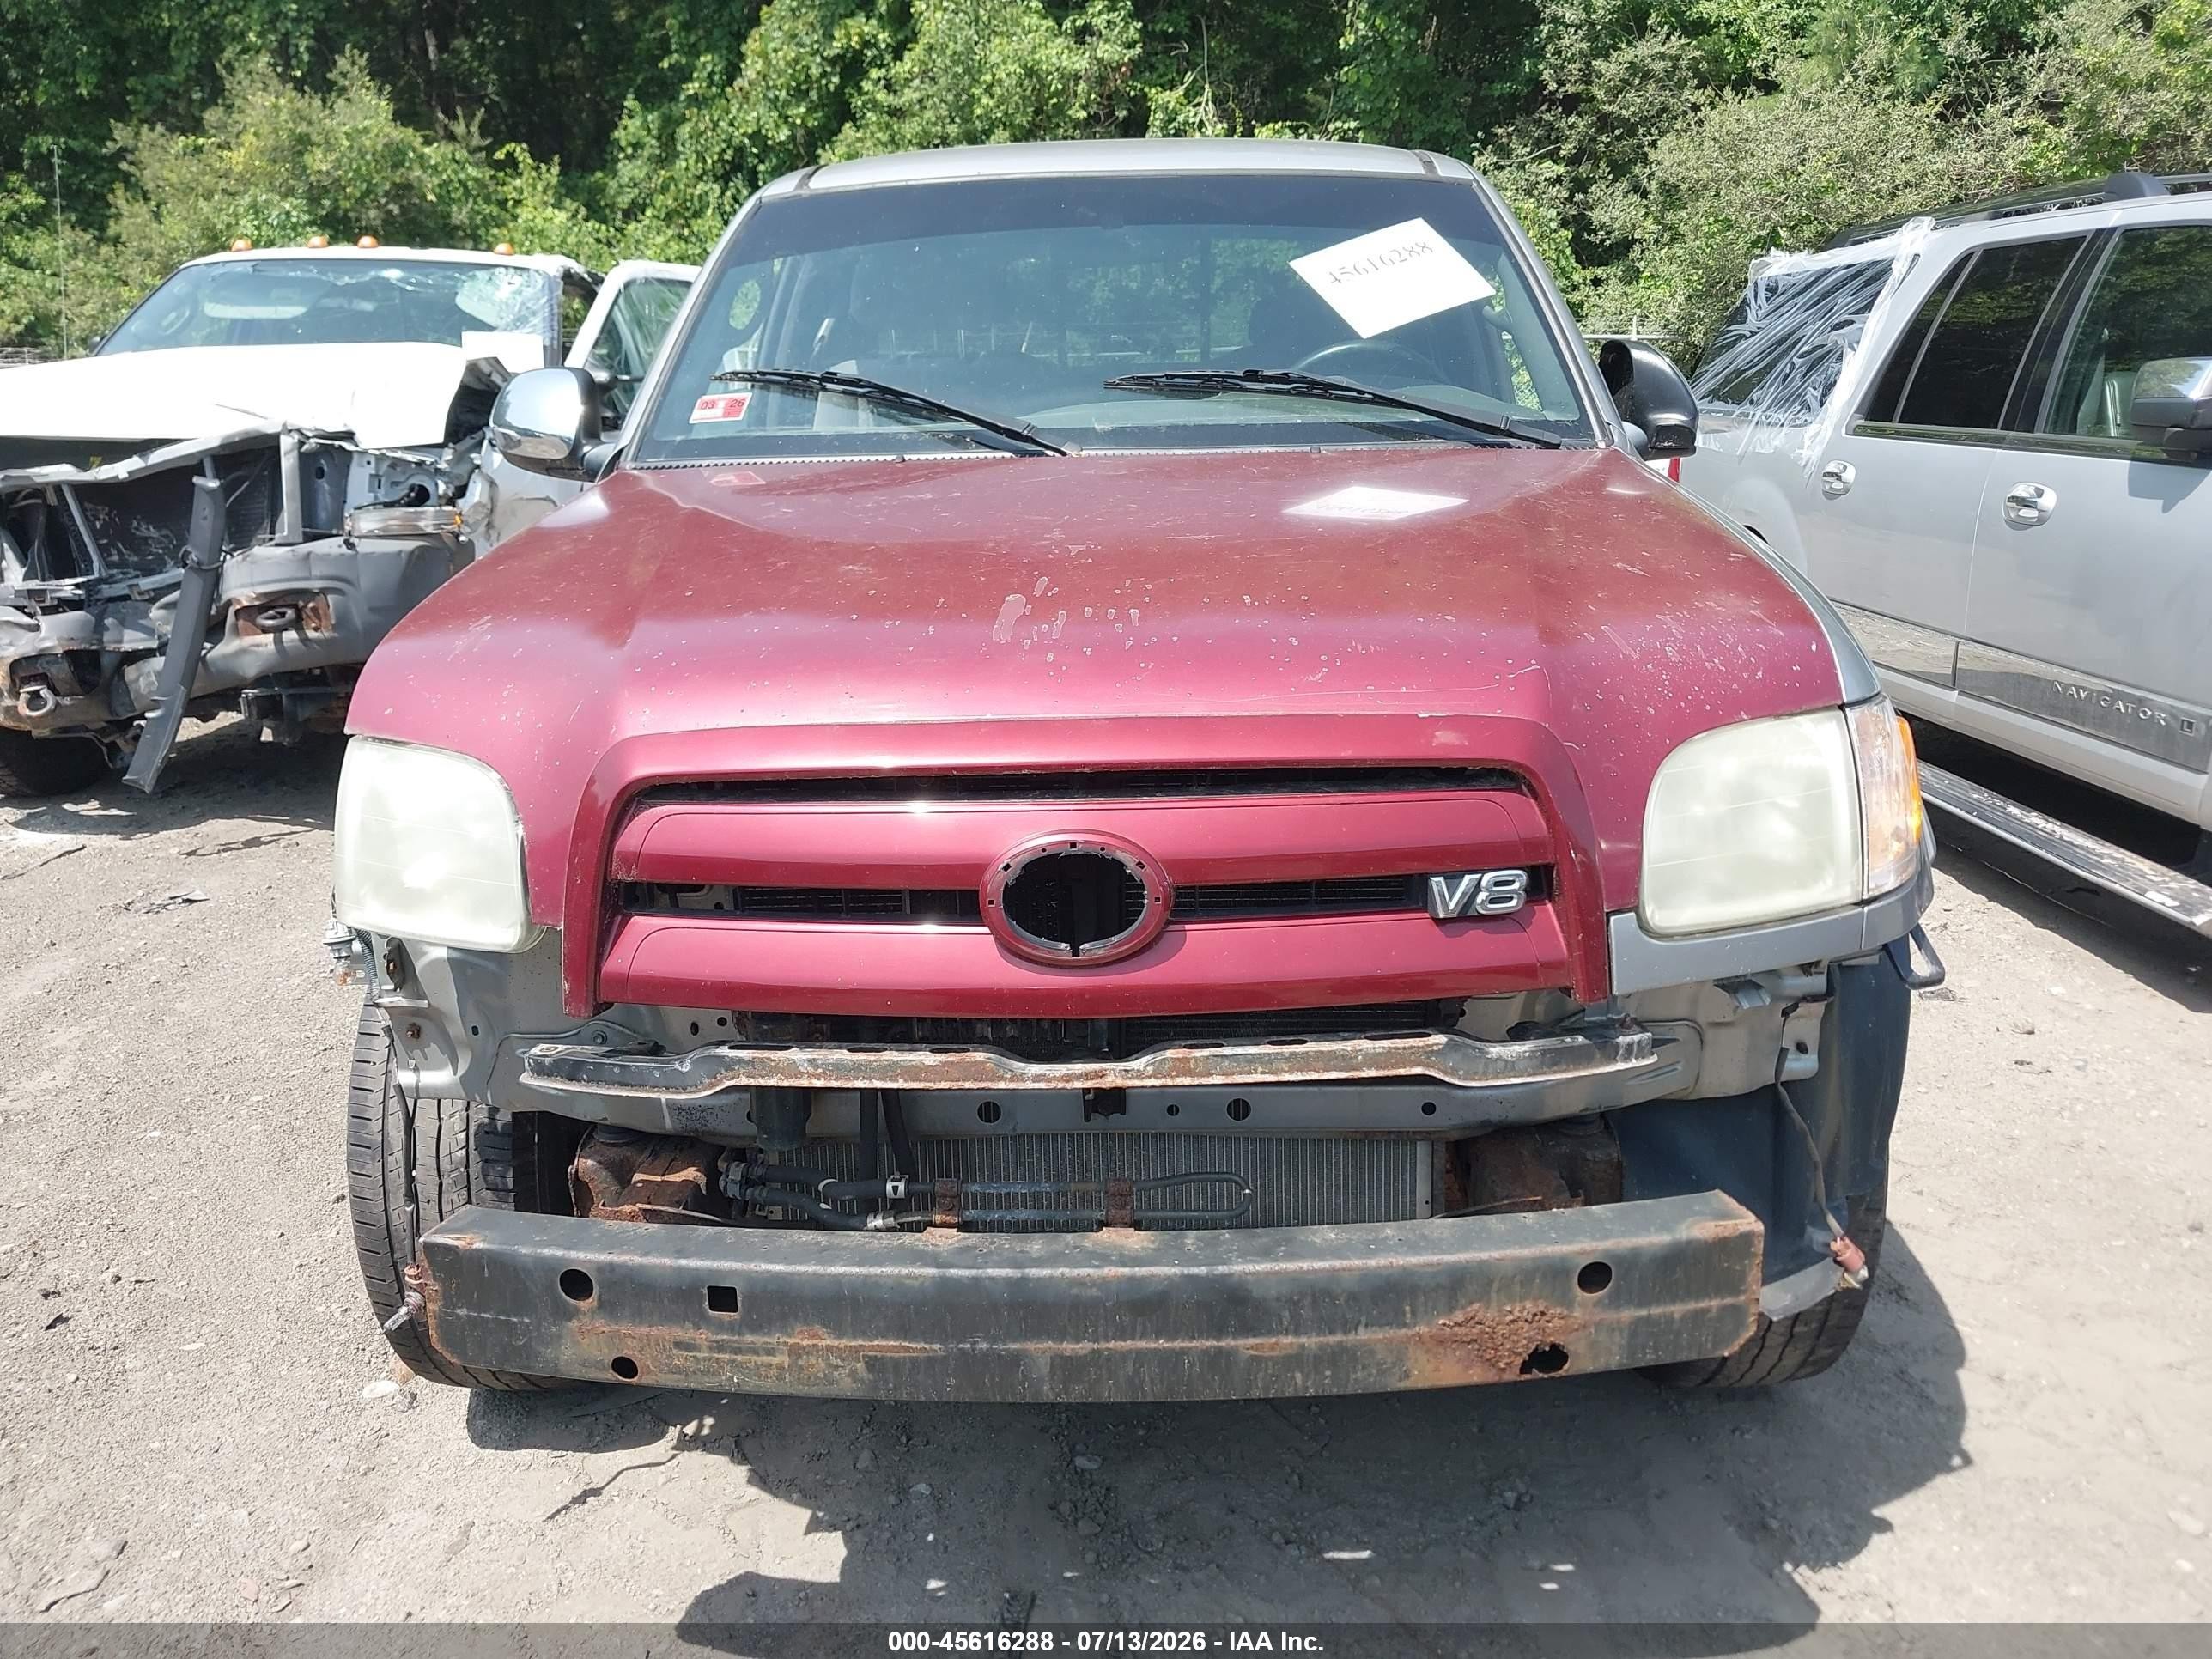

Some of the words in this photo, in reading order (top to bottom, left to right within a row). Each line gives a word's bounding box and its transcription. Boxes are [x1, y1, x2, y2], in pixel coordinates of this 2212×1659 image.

[1328, 241, 1434, 285] 45616288
[700, 400, 715, 410] 03
[729, 398, 746, 408] 26
[2052, 681, 2168, 726] NAVIGATOR
[1428, 869, 1528, 919] V8
